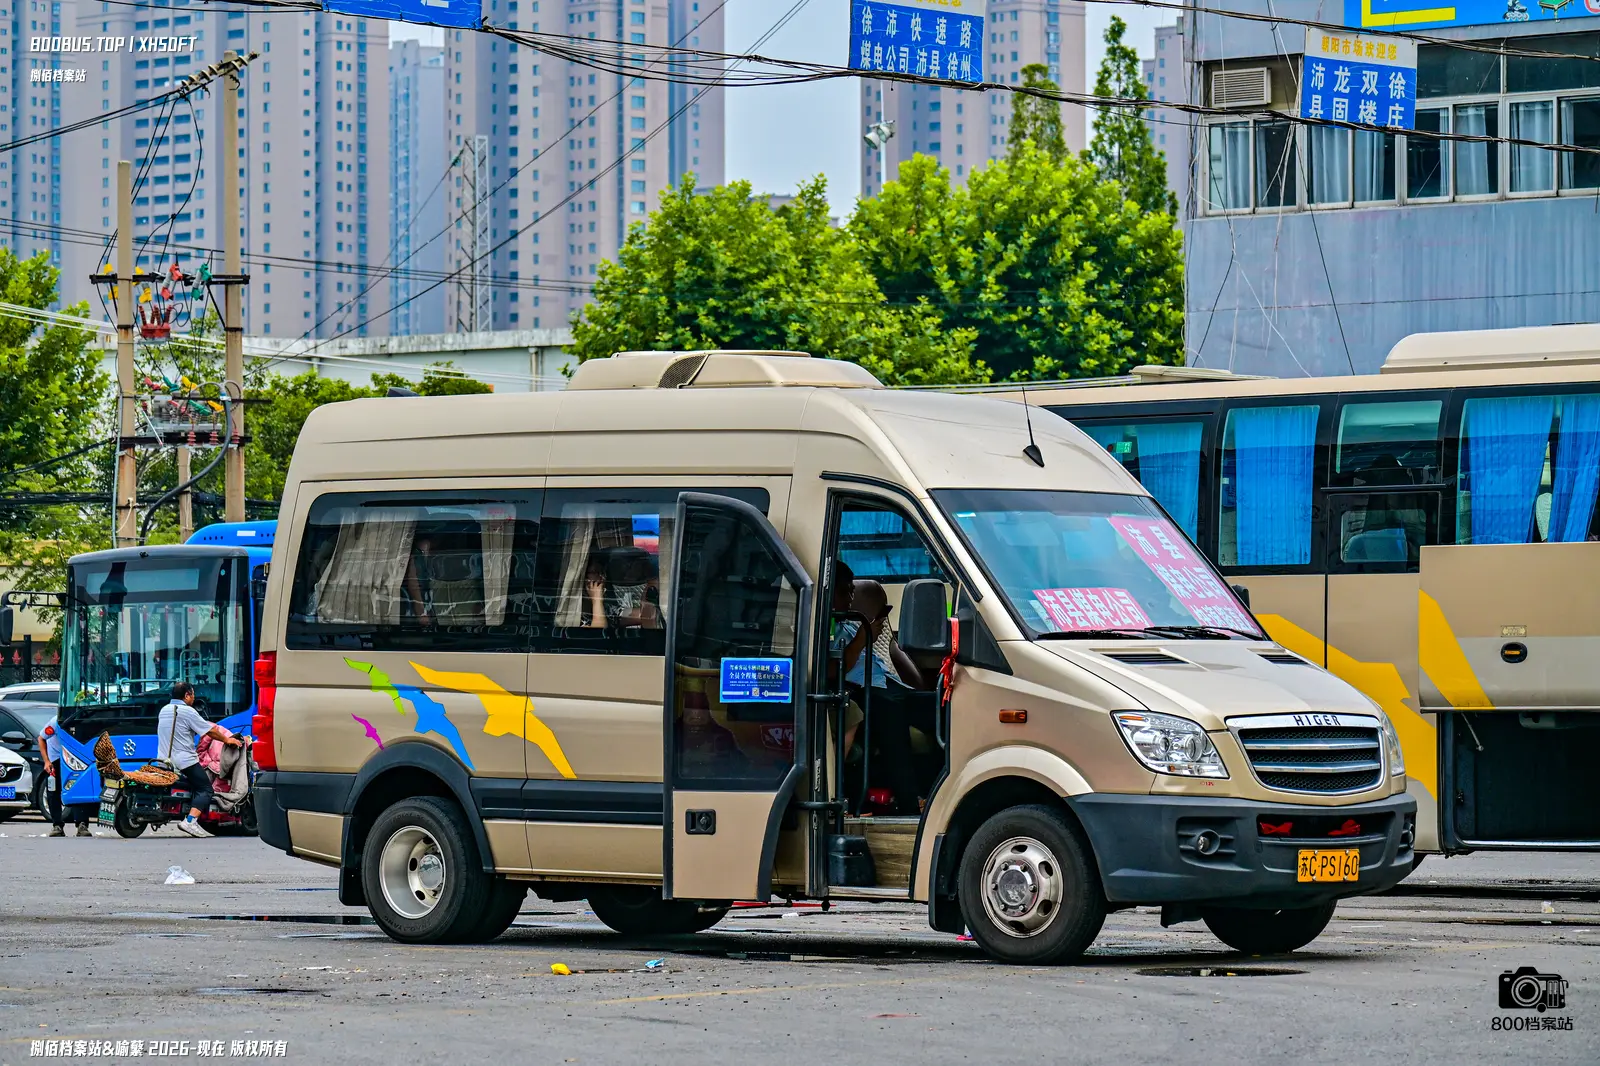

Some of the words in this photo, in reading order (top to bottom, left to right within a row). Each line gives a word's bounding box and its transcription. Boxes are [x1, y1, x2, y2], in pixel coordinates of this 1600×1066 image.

[861, 6, 972, 49] 徐沛快速路
[1321, 35, 1398, 61] 朝阳市场欢迎您
[860, 41, 910, 74] 煤电公司
[916, 49, 941, 79] 沛县
[947, 52, 972, 82] 徐州
[1037, 588, 1151, 629] 沛县煤电公司
[1293, 714, 1342, 726] HIGER
